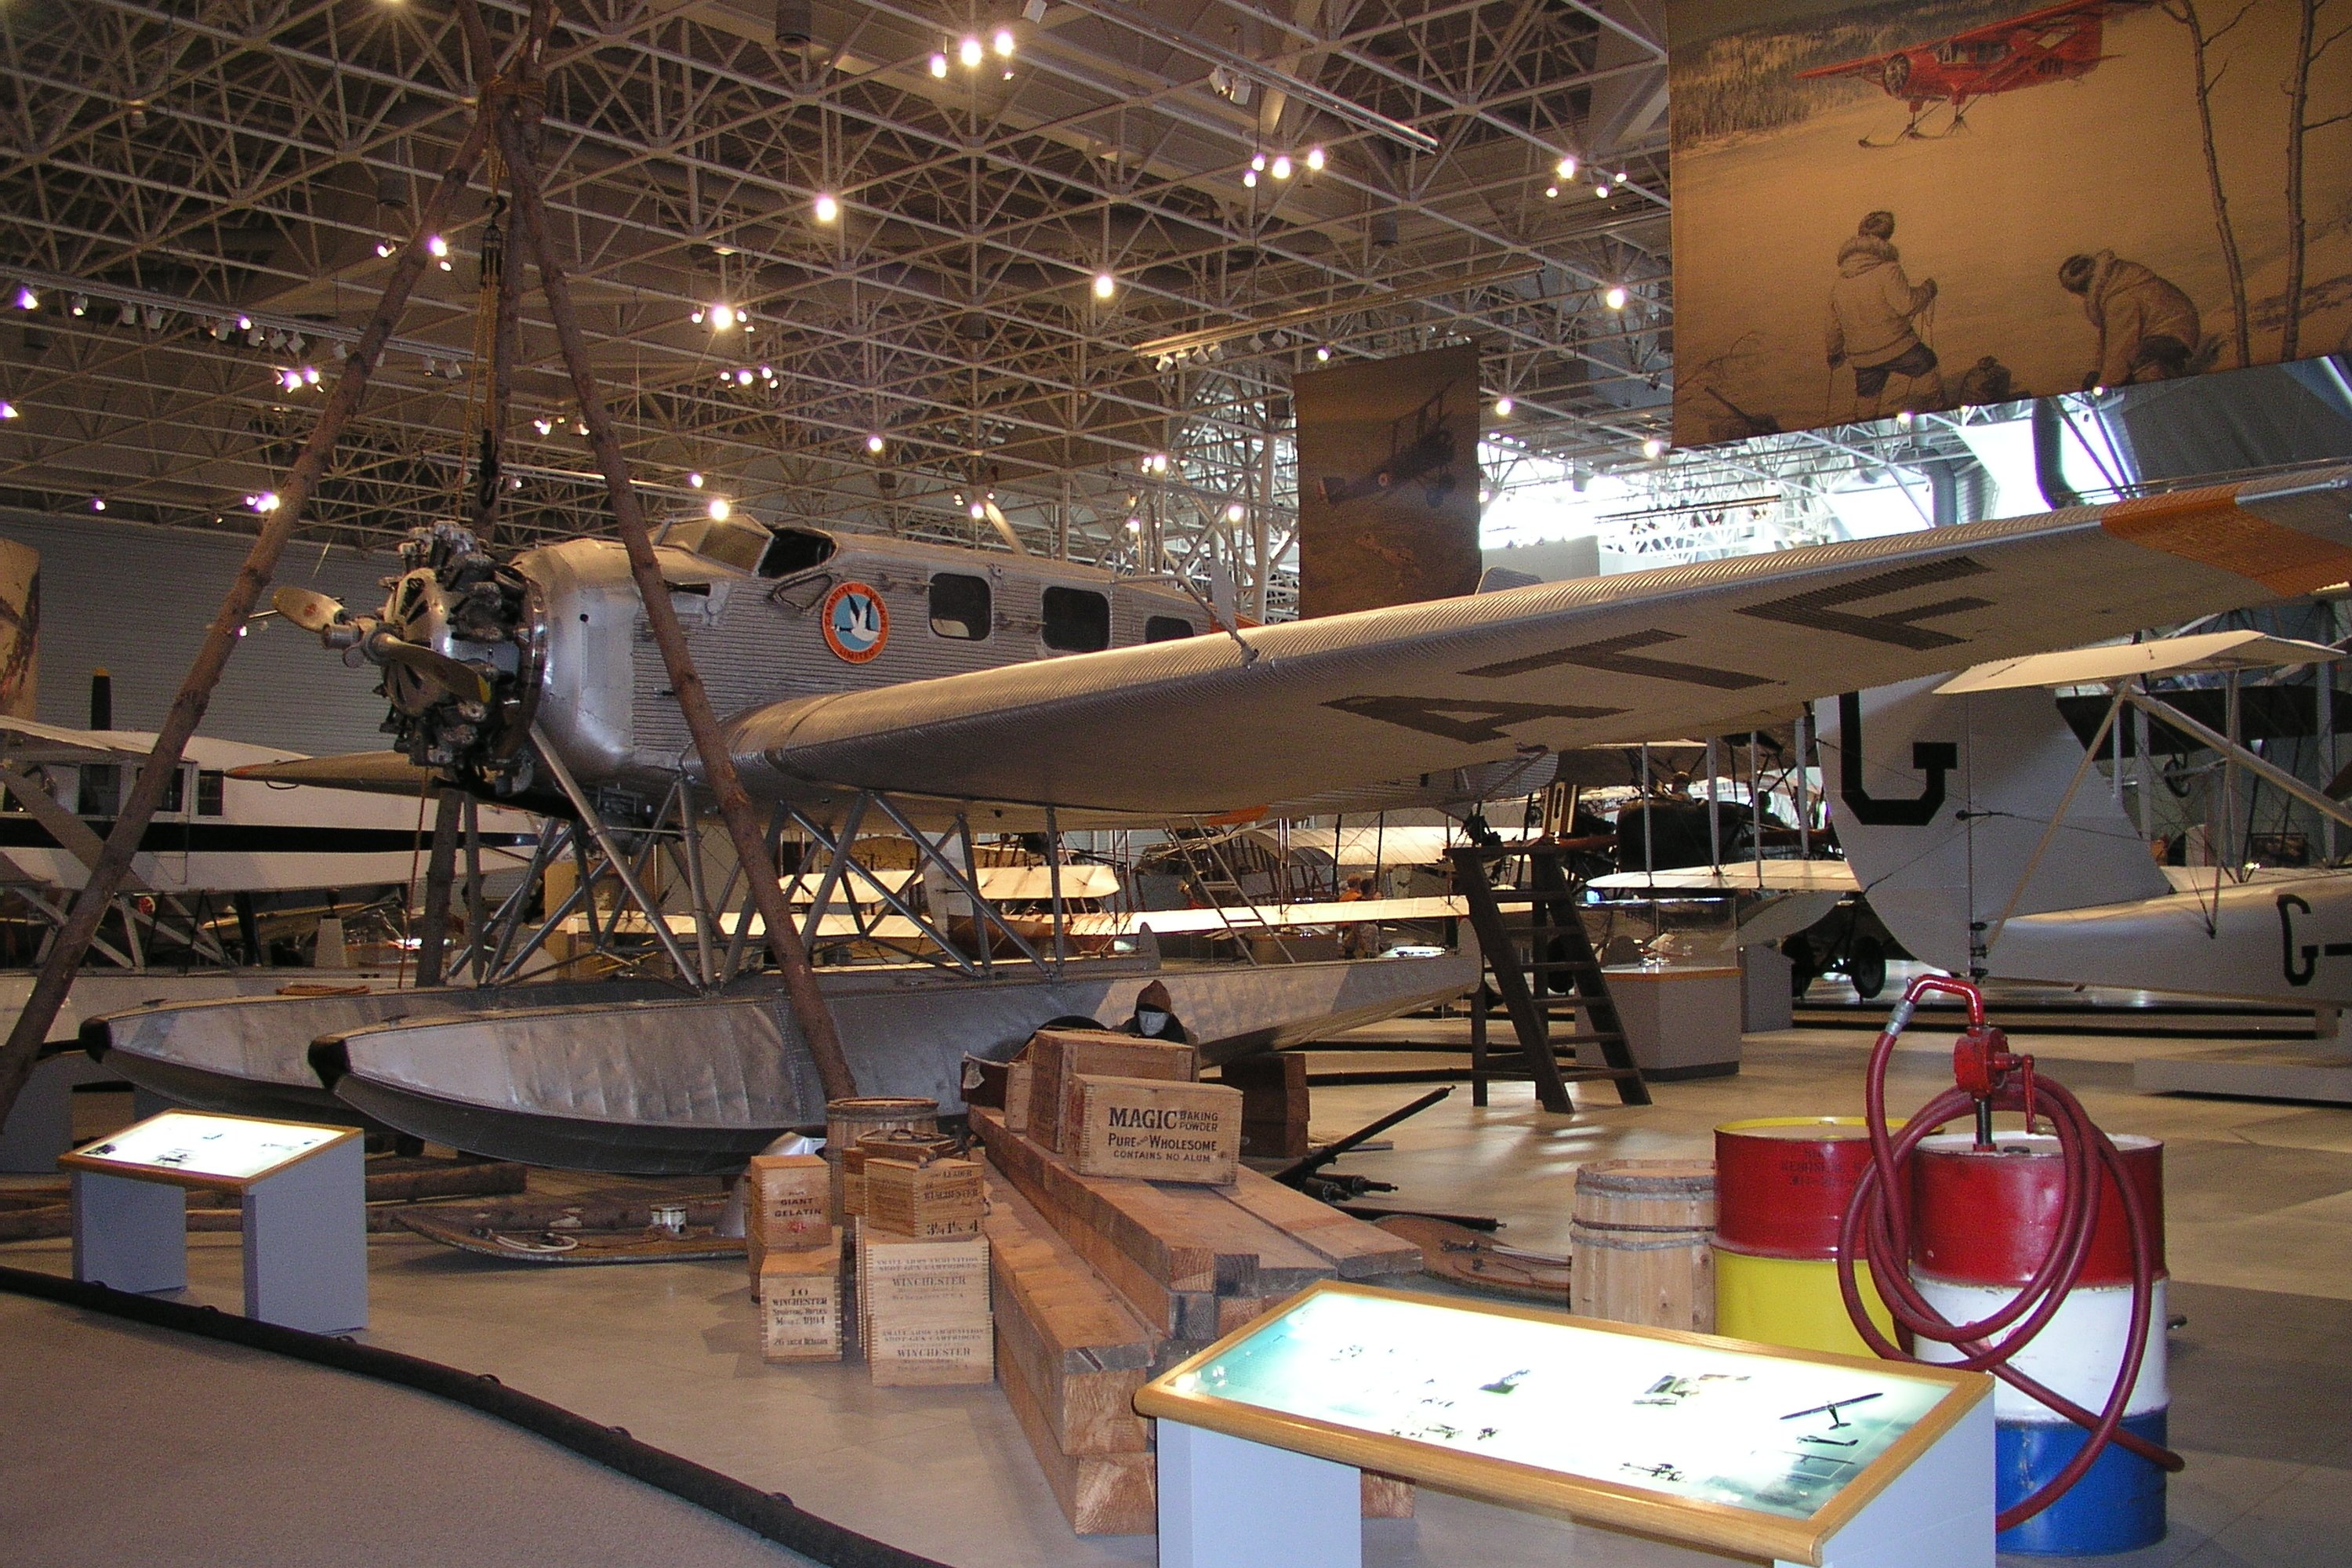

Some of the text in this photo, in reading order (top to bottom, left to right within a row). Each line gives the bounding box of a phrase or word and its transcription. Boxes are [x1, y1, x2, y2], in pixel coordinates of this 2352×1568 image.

[1108, 1106, 1178, 1130] MAGIC
[1178, 1110, 1218, 1122] BAKING
[1178, 1122, 1218, 1133] POWDER
[1107, 1132, 1137, 1147] PURE
[1149, 1134, 1218, 1152] WHOLESOME
[1113, 1149, 1210, 1163] CONTAINS NO ALUM
[924, 1188, 978, 1200] WINCHESTER
[780, 1197, 814, 1206] GIANT
[775, 1207, 822, 1218] GELATIN
[892, 1276, 967, 1287] WINCHESTER
[772, 1297, 827, 1306] WINCHESTER
[897, 1346, 971, 1358] WINCHESTER
